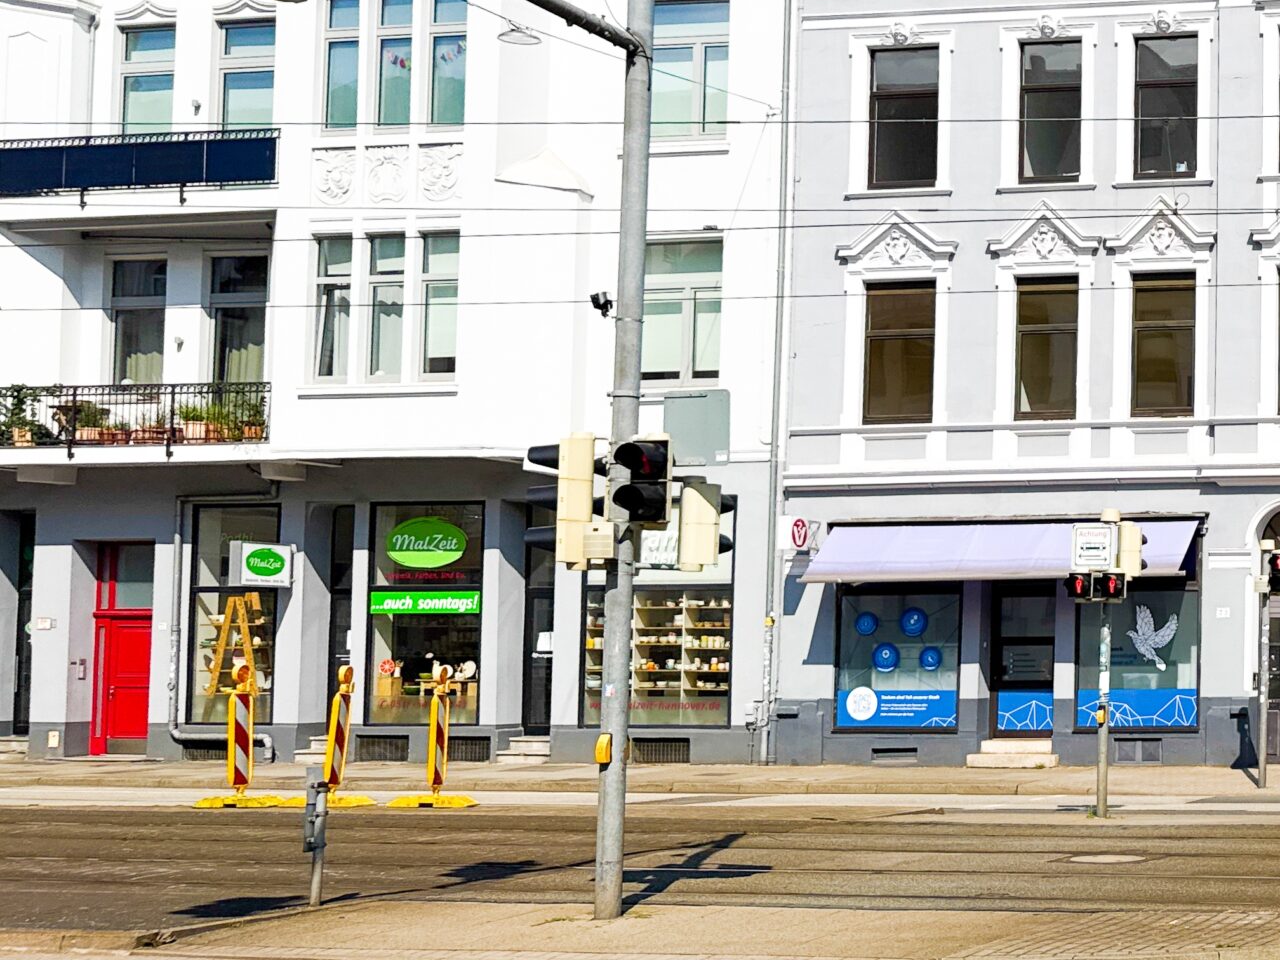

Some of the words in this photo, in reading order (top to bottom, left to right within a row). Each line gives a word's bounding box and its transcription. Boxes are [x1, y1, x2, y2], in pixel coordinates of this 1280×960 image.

[1079, 531, 1107, 539] Achtung
[392, 534, 458, 553] MalZeit
[249, 557, 281, 569] MalZeit
[371, 596, 413, 610] ...auch
[417, 595, 479, 612] sonntags!
